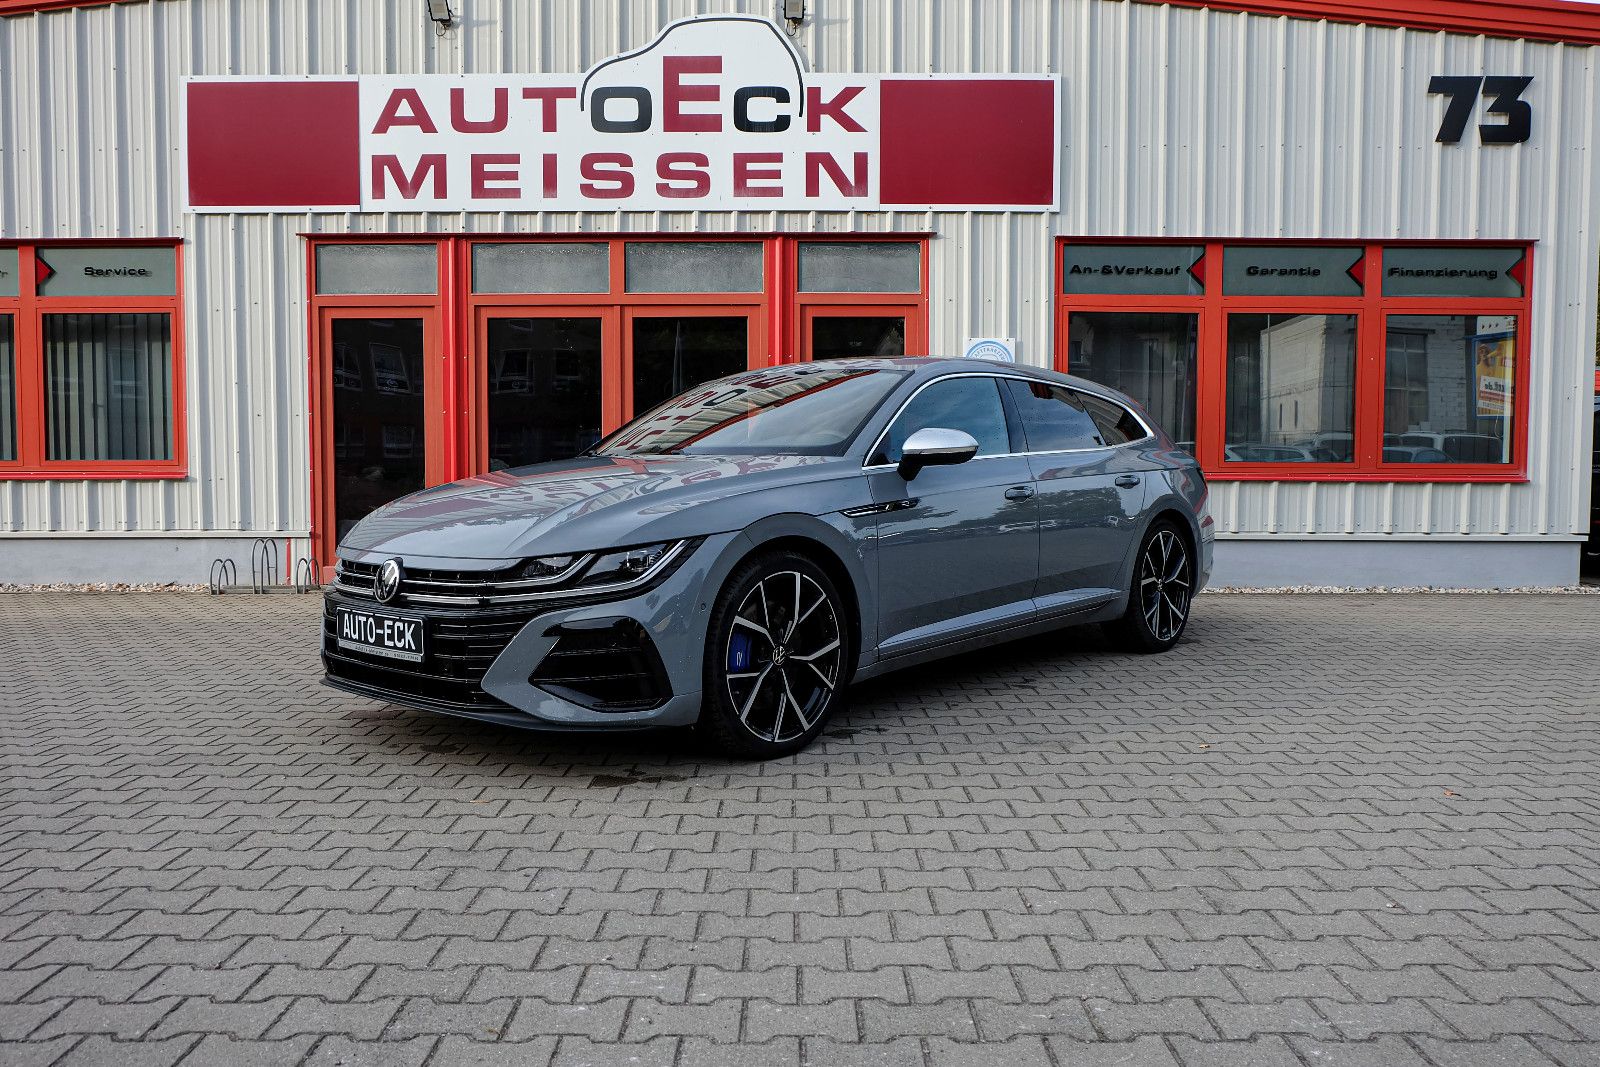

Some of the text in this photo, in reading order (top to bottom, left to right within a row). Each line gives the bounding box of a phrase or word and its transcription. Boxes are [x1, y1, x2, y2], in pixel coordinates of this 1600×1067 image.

[1428, 76, 1534, 143] 73
[372, 151, 867, 200] MEISSEN
[84, 266, 147, 276] Service
[1246, 266, 1321, 276] Garantie
[1388, 267, 1498, 280] Finanzierung
[343, 613, 416, 650] AUTO-ECK
